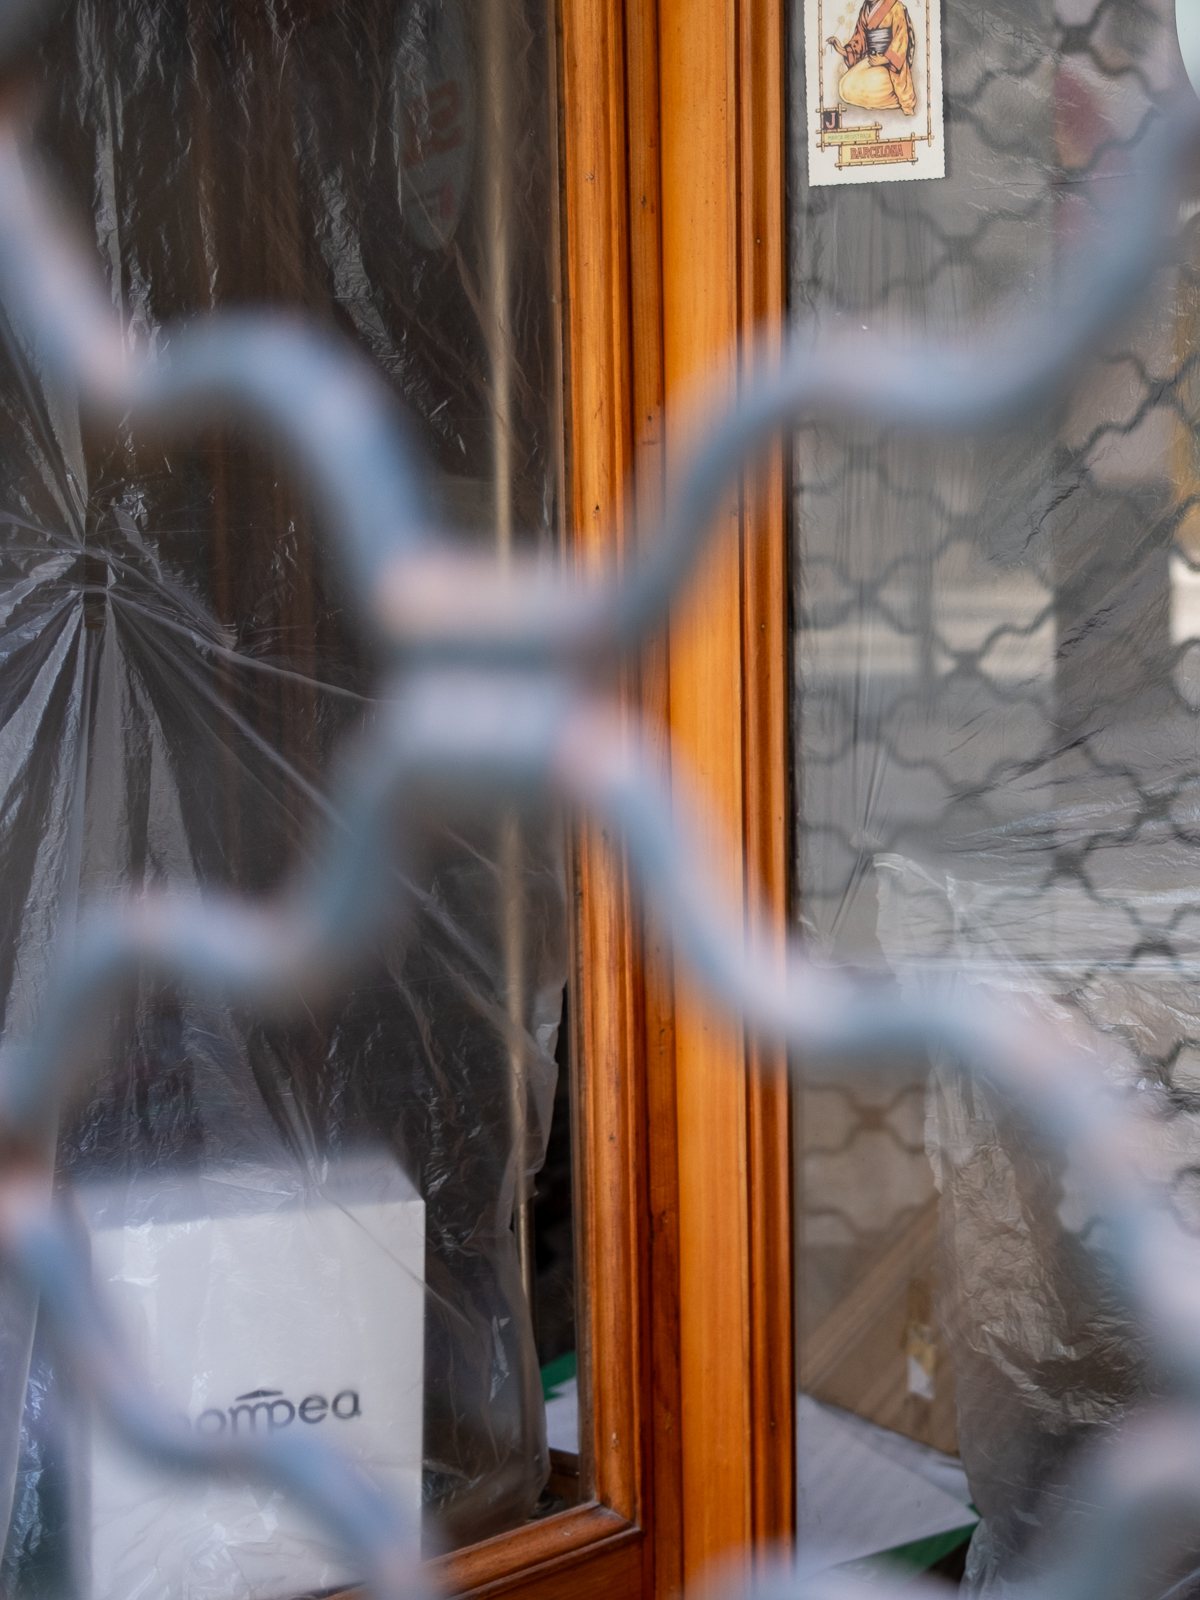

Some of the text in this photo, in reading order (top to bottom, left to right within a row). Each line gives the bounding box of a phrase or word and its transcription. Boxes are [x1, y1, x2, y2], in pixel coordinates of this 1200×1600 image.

[825, 112, 836, 129] J
[850, 144, 904, 160] BARCELONA
[172, 1388, 361, 1436] ompea
